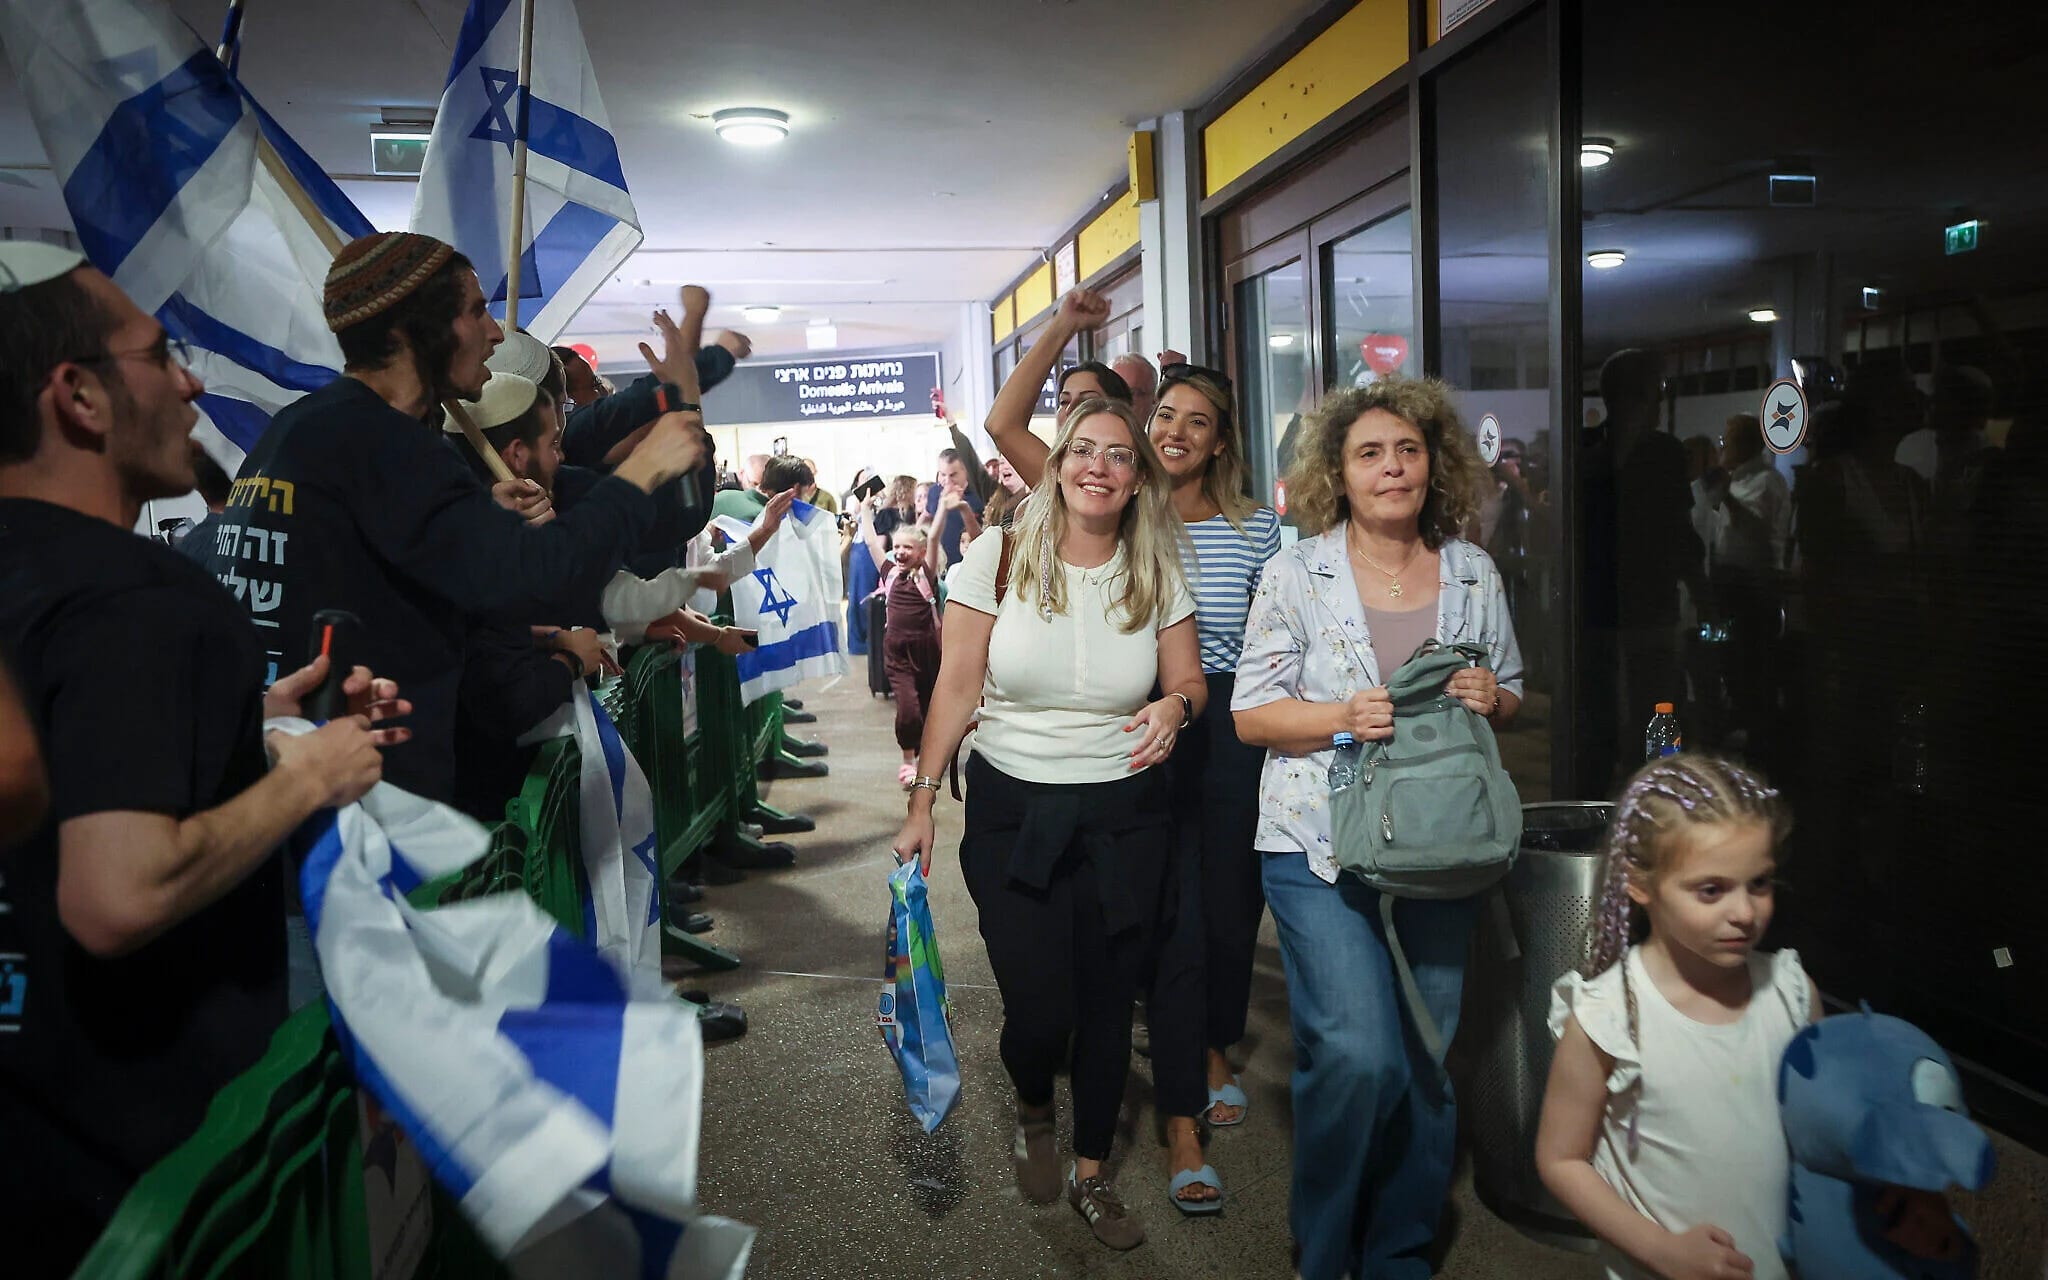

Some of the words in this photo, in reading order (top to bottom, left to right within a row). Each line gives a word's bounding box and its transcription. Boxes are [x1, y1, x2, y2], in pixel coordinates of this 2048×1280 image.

[774, 367, 810, 383] ארצי
[813, 365, 847, 380] פנים
[850, 361, 904, 379] נחיתות
[799, 381, 857, 398] Domestic
[858, 379, 905, 395] Arrivals
[225, 469, 295, 515] הילדים
[242, 526, 289, 565] זה
